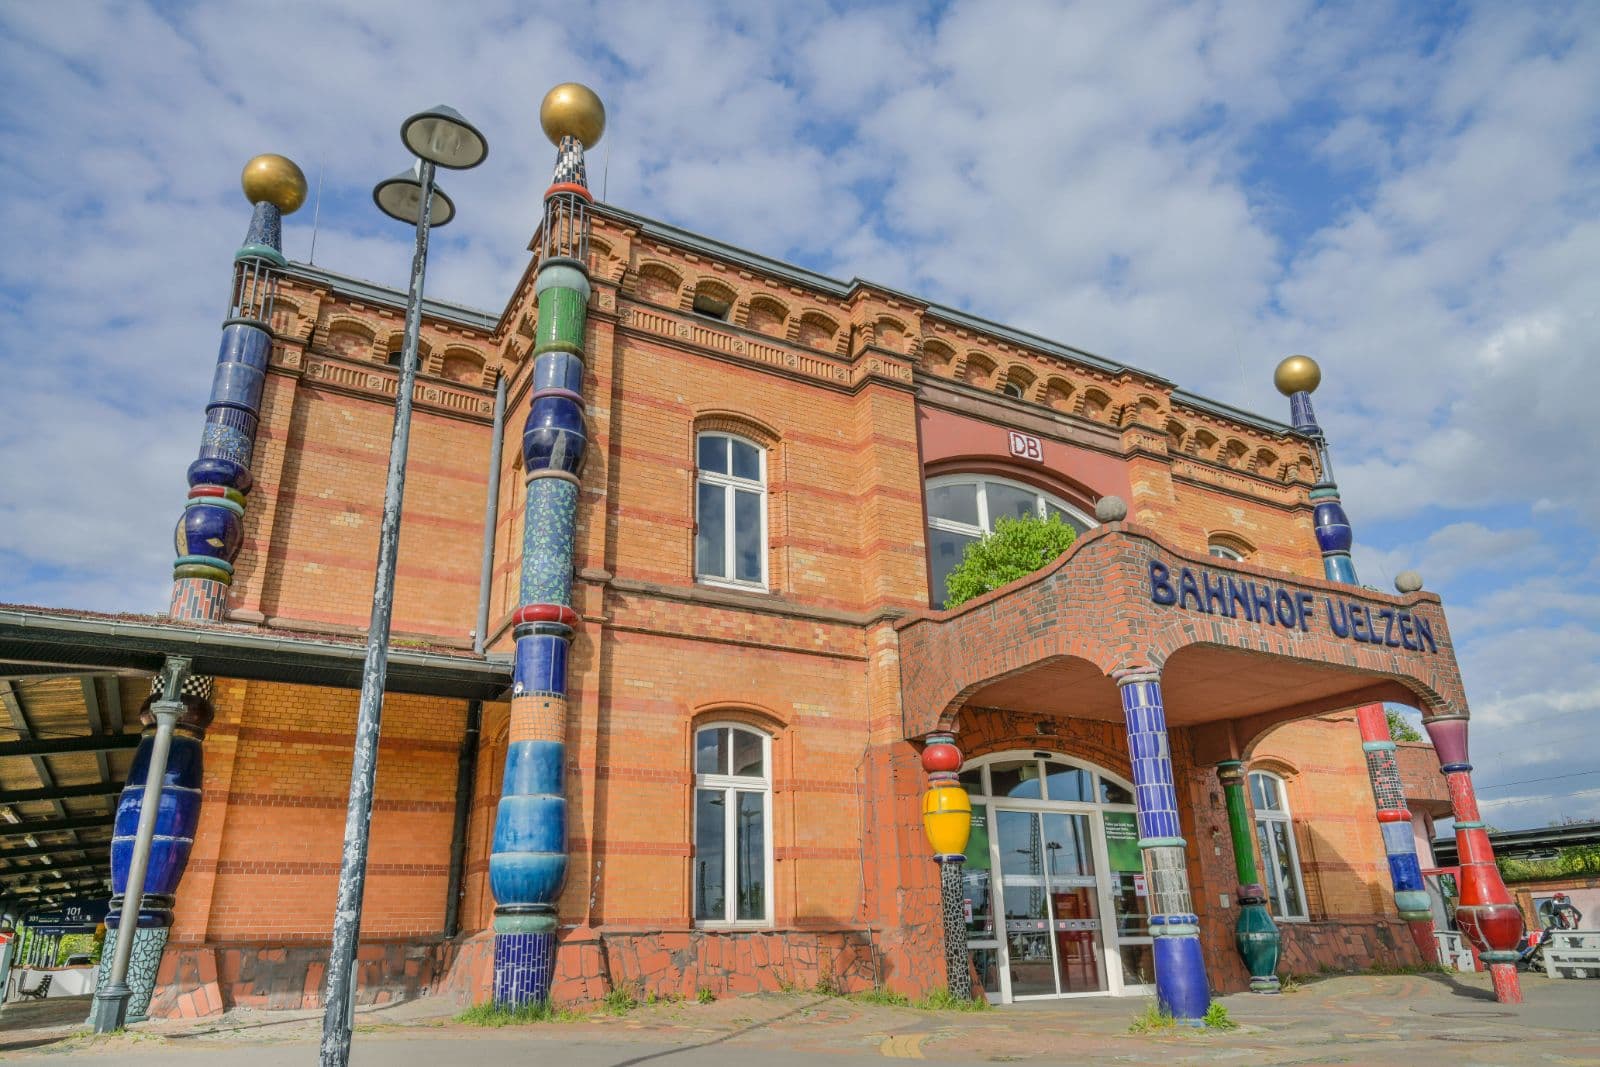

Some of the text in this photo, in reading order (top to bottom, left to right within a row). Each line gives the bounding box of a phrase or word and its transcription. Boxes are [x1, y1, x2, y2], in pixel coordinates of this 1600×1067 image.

[1012, 433, 1040, 459] DB
[1148, 559, 1438, 654] BAHNHOF UELZEN
[66, 907, 81, 916] 101
